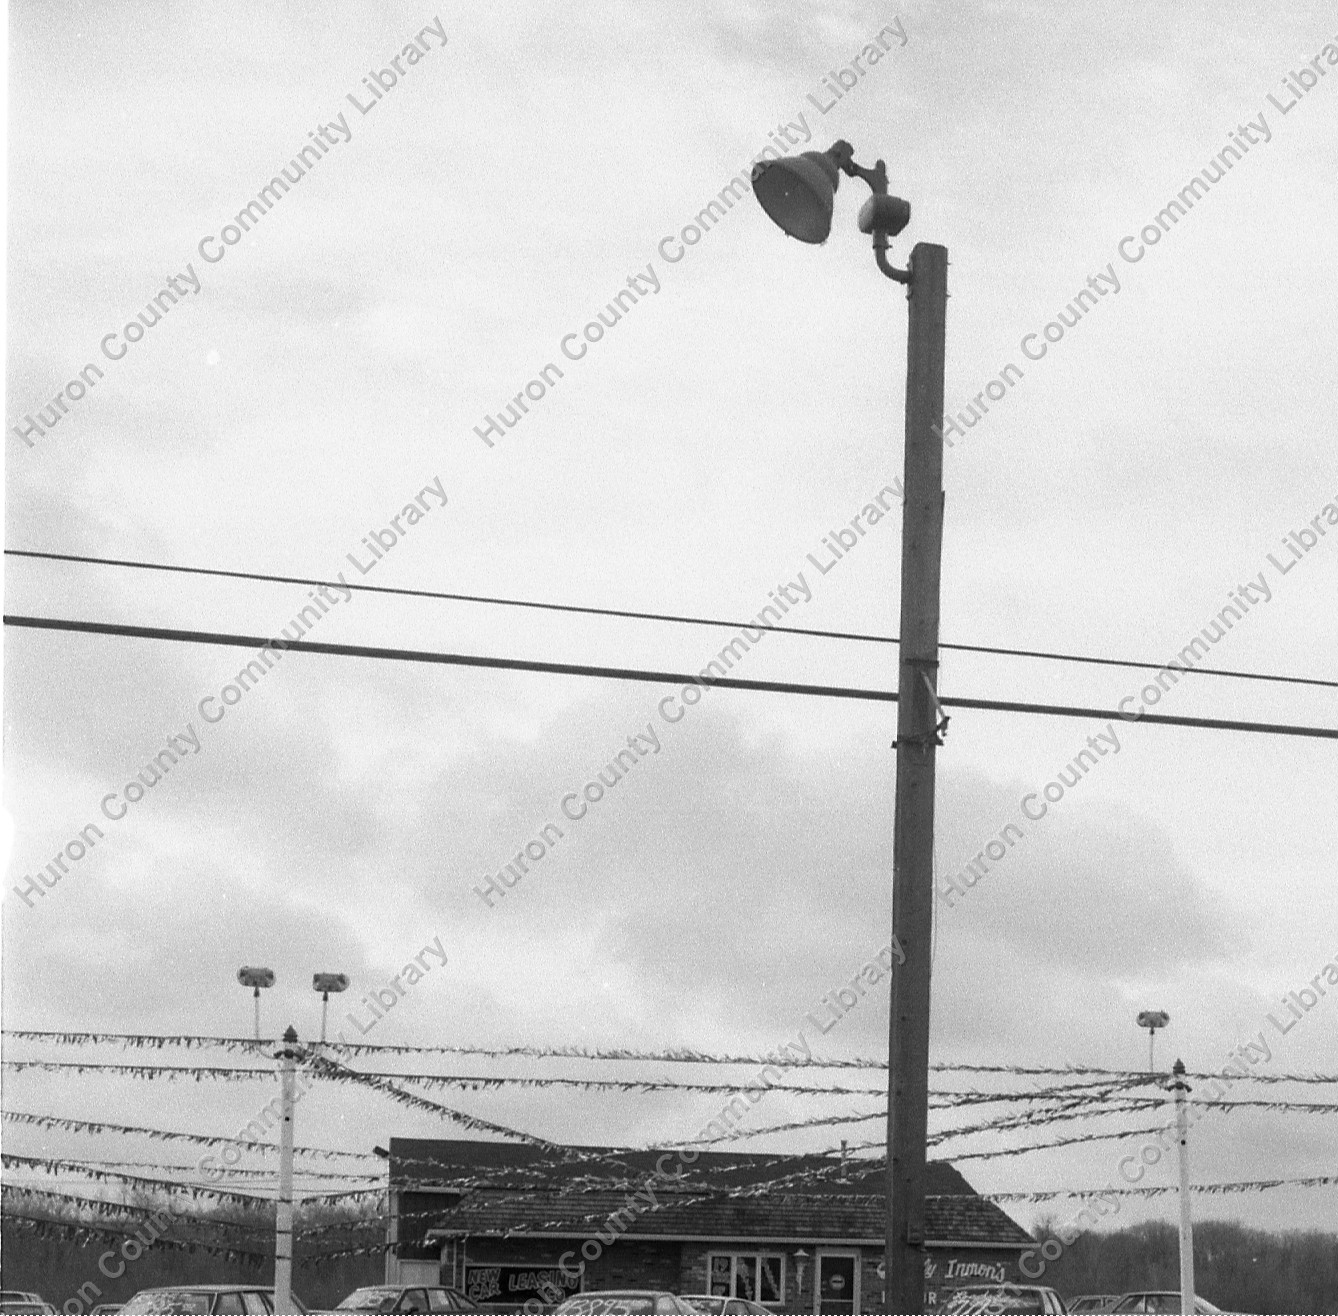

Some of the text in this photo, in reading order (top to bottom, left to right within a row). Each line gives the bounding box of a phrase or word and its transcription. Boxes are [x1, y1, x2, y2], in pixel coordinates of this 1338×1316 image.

[468, 1268, 501, 1285] NEW
[508, 1270, 578, 1291] LEASING
[468, 1283, 501, 1301] CAR
